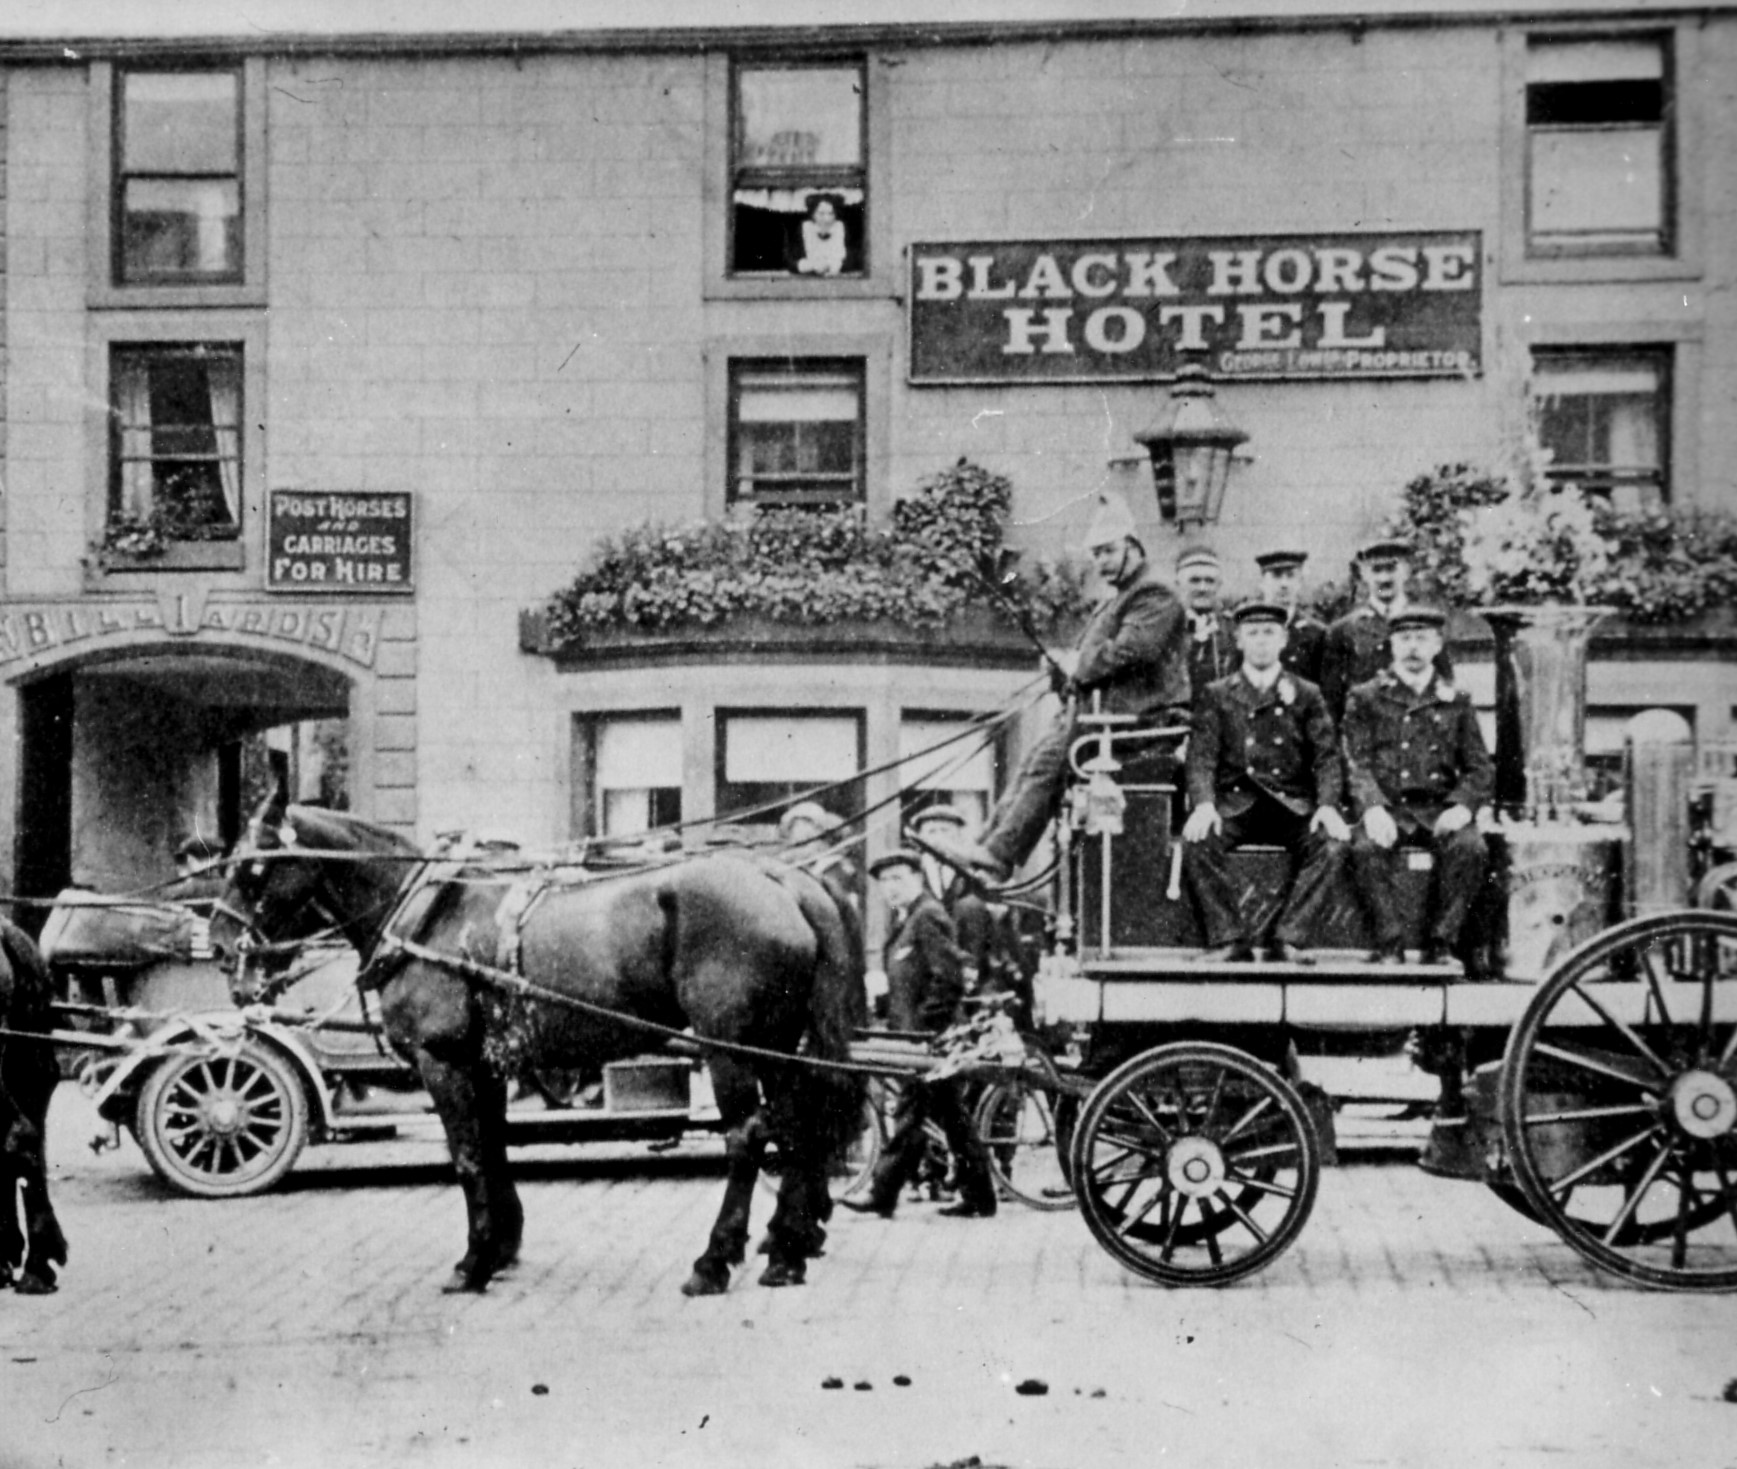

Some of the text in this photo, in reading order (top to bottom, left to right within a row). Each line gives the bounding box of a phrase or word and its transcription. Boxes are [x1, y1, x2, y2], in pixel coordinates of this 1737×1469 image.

[916, 244, 1476, 300] BLACK HORSE
[1002, 301, 1386, 355] HOTEL
[274, 495, 407, 520] POST HORSES
[283, 534, 397, 555] CARRIAGES
[273, 556, 402, 584] FOR HIRE
